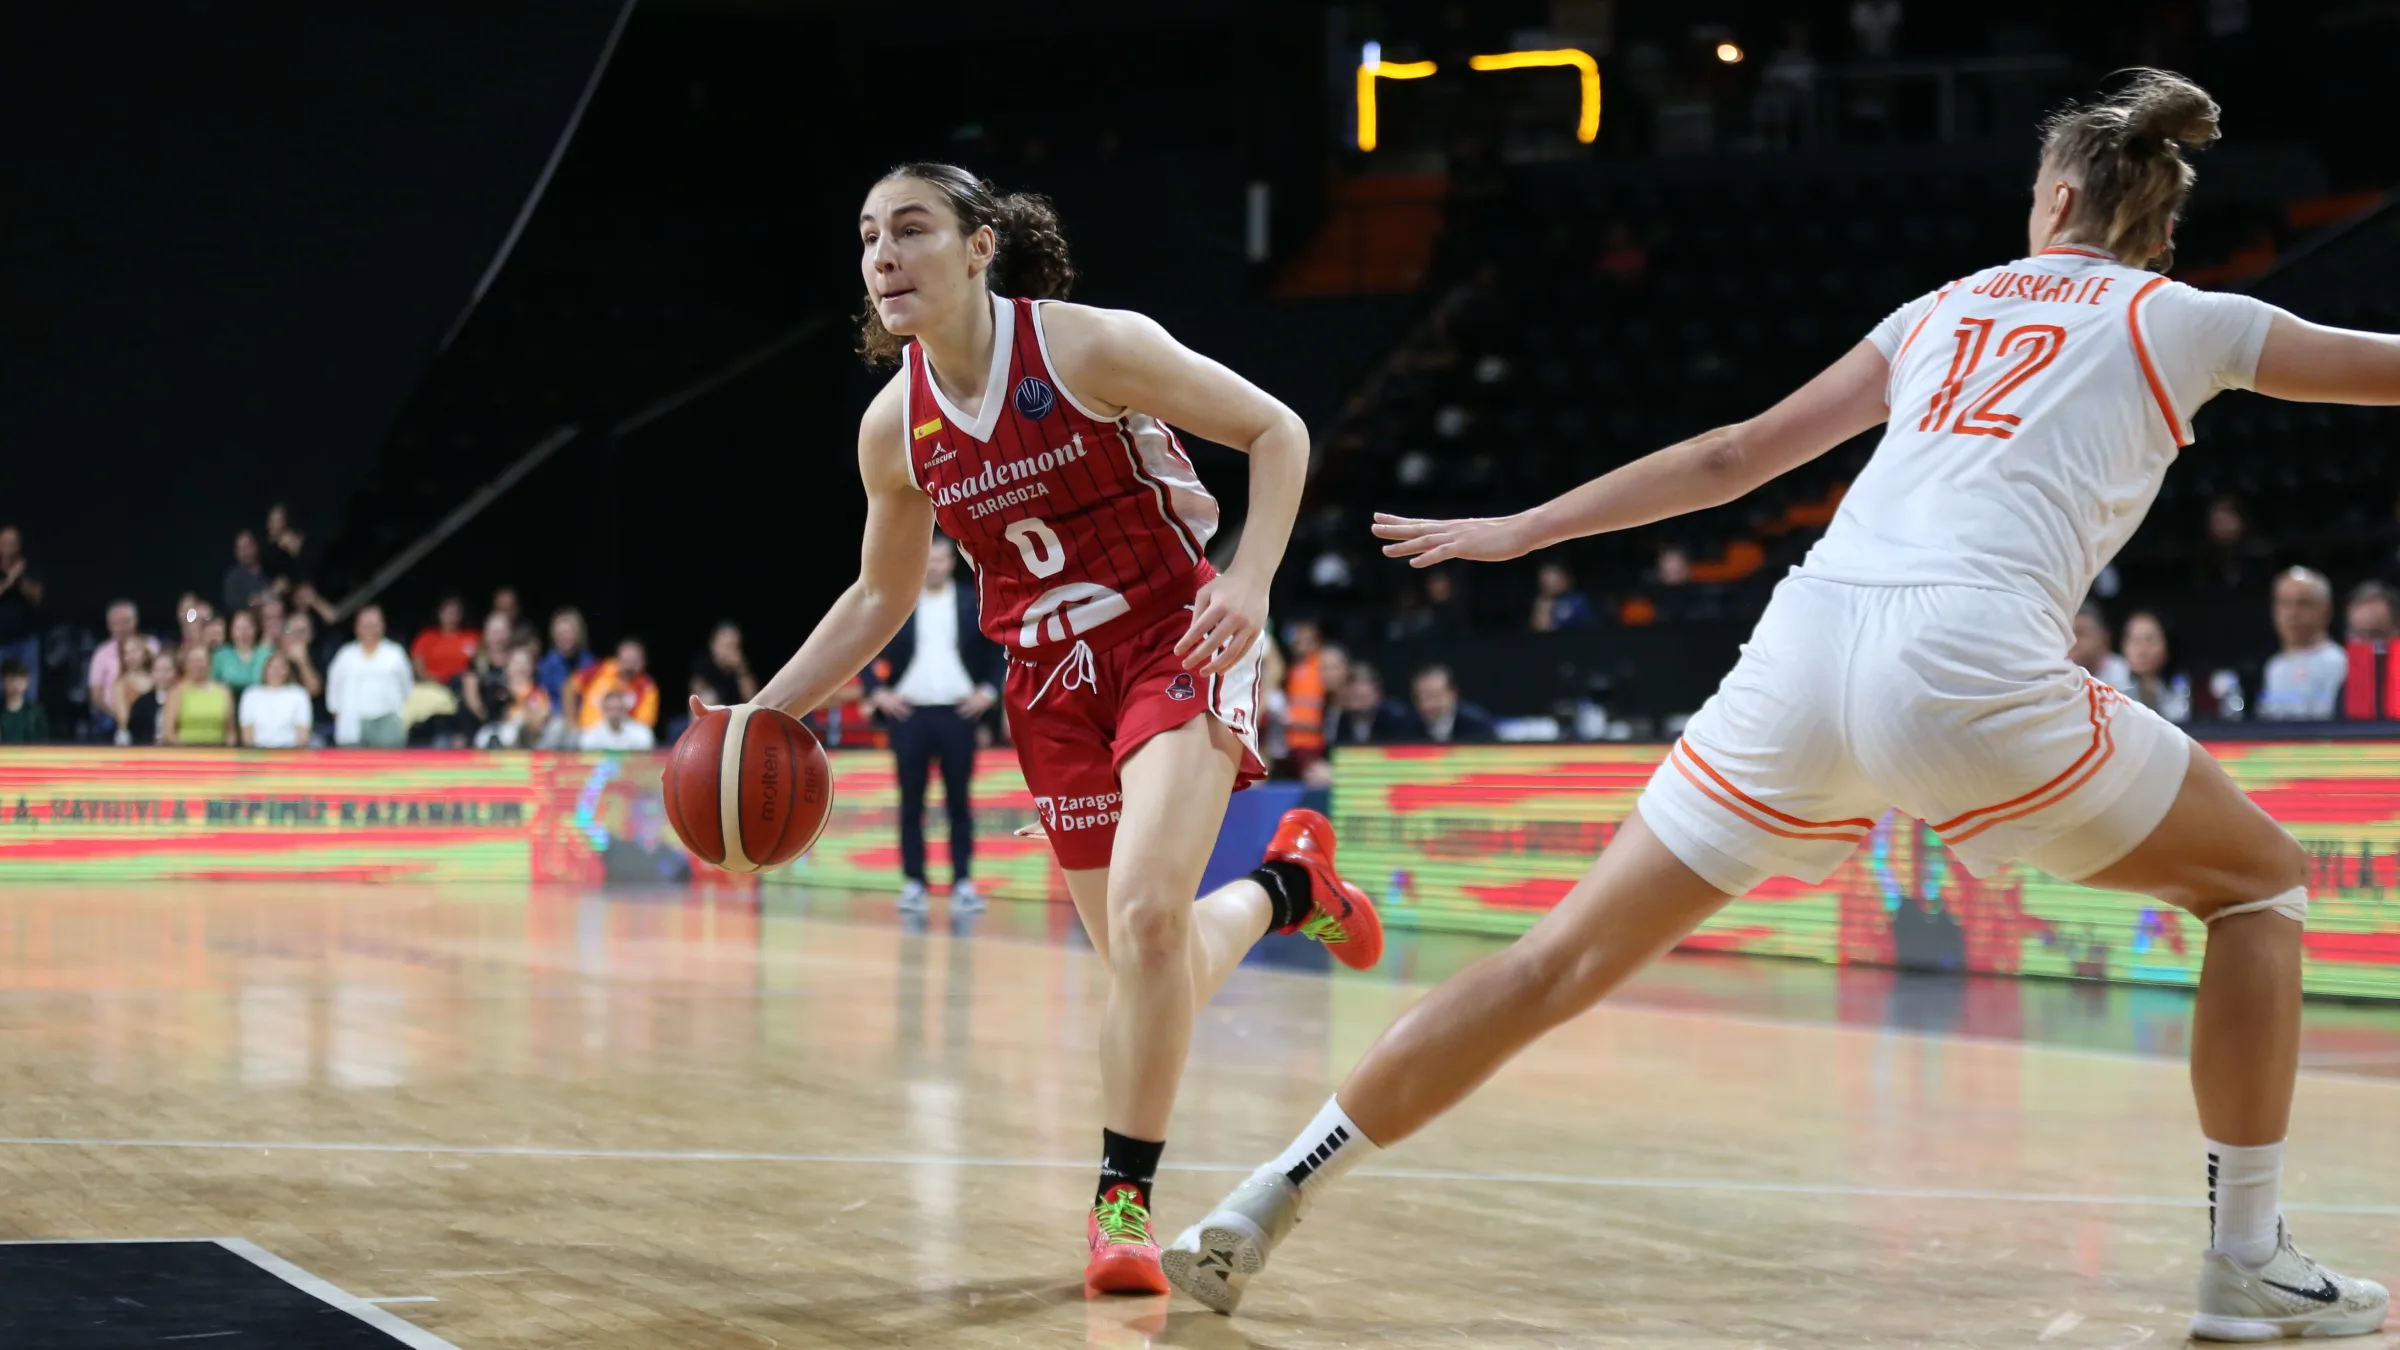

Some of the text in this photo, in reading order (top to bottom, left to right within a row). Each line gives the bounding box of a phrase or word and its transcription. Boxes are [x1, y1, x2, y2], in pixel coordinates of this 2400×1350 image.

[1918, 317, 2067, 439] 12
[924, 450, 957, 470] MERCURY
[927, 432, 1088, 508] Casademont
[967, 481, 1049, 520] ZARAGOZA
[1005, 517, 1066, 579] 0
[761, 746, 778, 821] molten
[1058, 792, 1123, 811] Zaragoz
[1061, 810, 1123, 831] DEPOR
